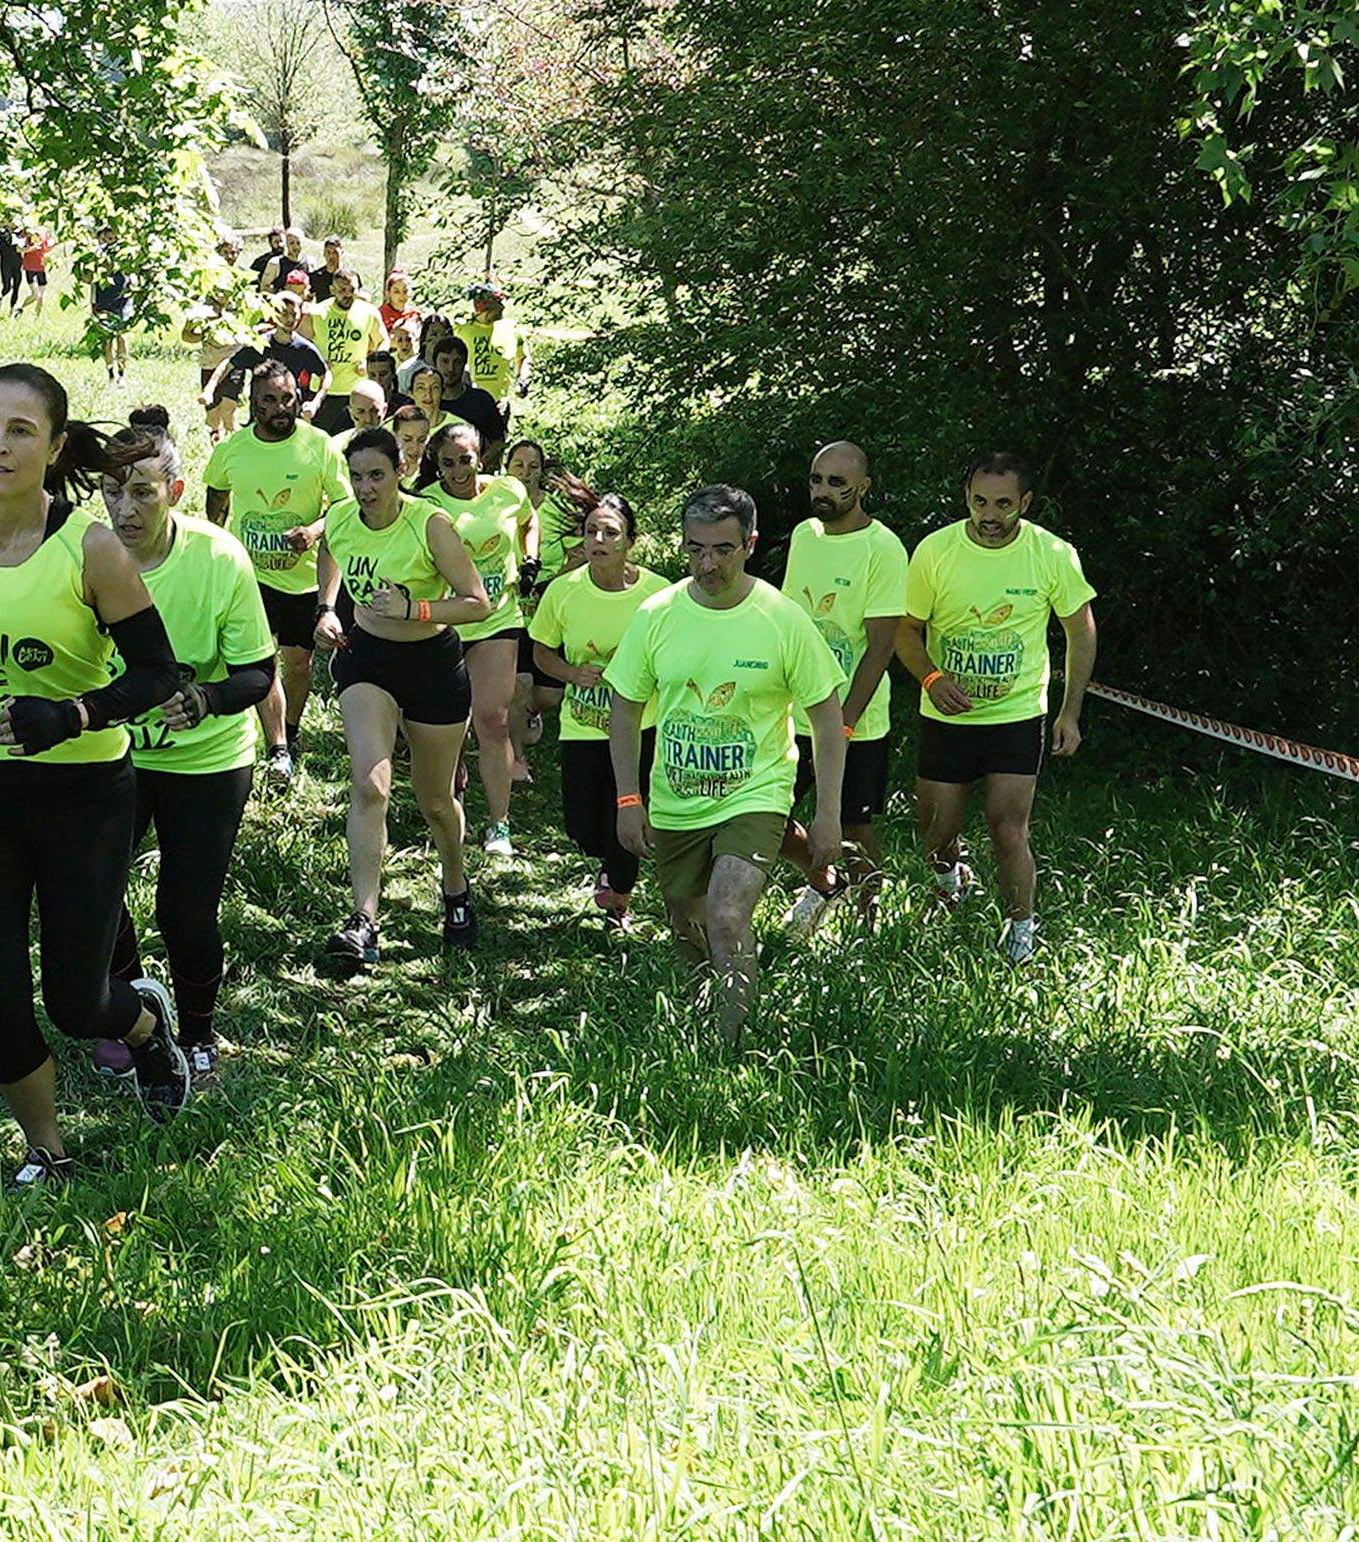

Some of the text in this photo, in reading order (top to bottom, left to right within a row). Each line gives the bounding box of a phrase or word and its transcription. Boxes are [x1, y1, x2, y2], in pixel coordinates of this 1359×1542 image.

[348, 555, 379, 579] UN
[947, 647, 1015, 675] TRAINER
[976, 684, 1000, 699] LIFE
[665, 737, 745, 772] TRAINER
[699, 778, 727, 798] LIFE
